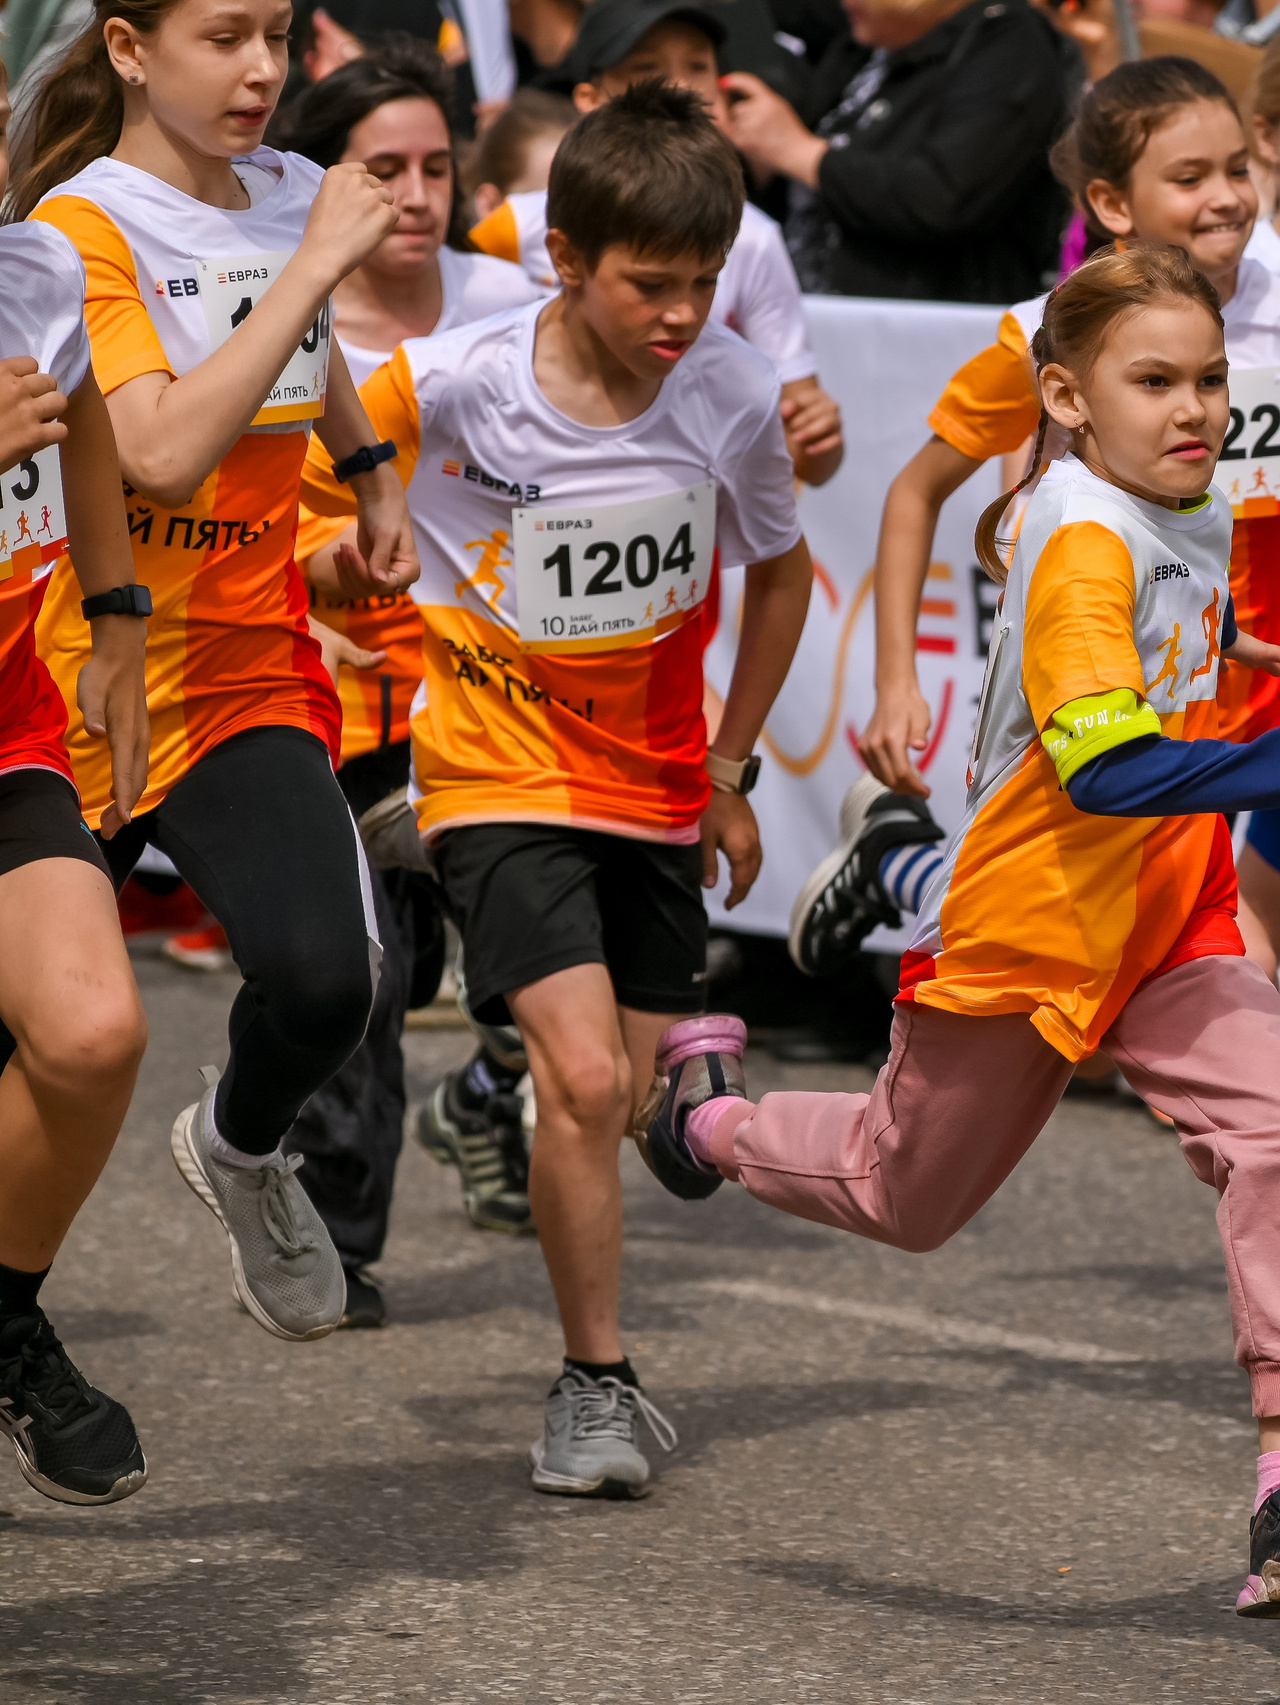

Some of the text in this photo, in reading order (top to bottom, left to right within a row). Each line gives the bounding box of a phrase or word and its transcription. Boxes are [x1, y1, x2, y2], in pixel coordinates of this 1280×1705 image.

[228, 268, 268, 283] ЕВРАЗ
[284, 385, 309, 400] ПЯТЬ
[546, 519, 593, 531] ЕВРАЗ
[543, 521, 695, 598] 1204
[1154, 562, 1190, 582] ЕВРАЗ
[541, 616, 635, 636] 10 ДАЙ ПЯТЬ
[1073, 709, 1109, 738] FUN
